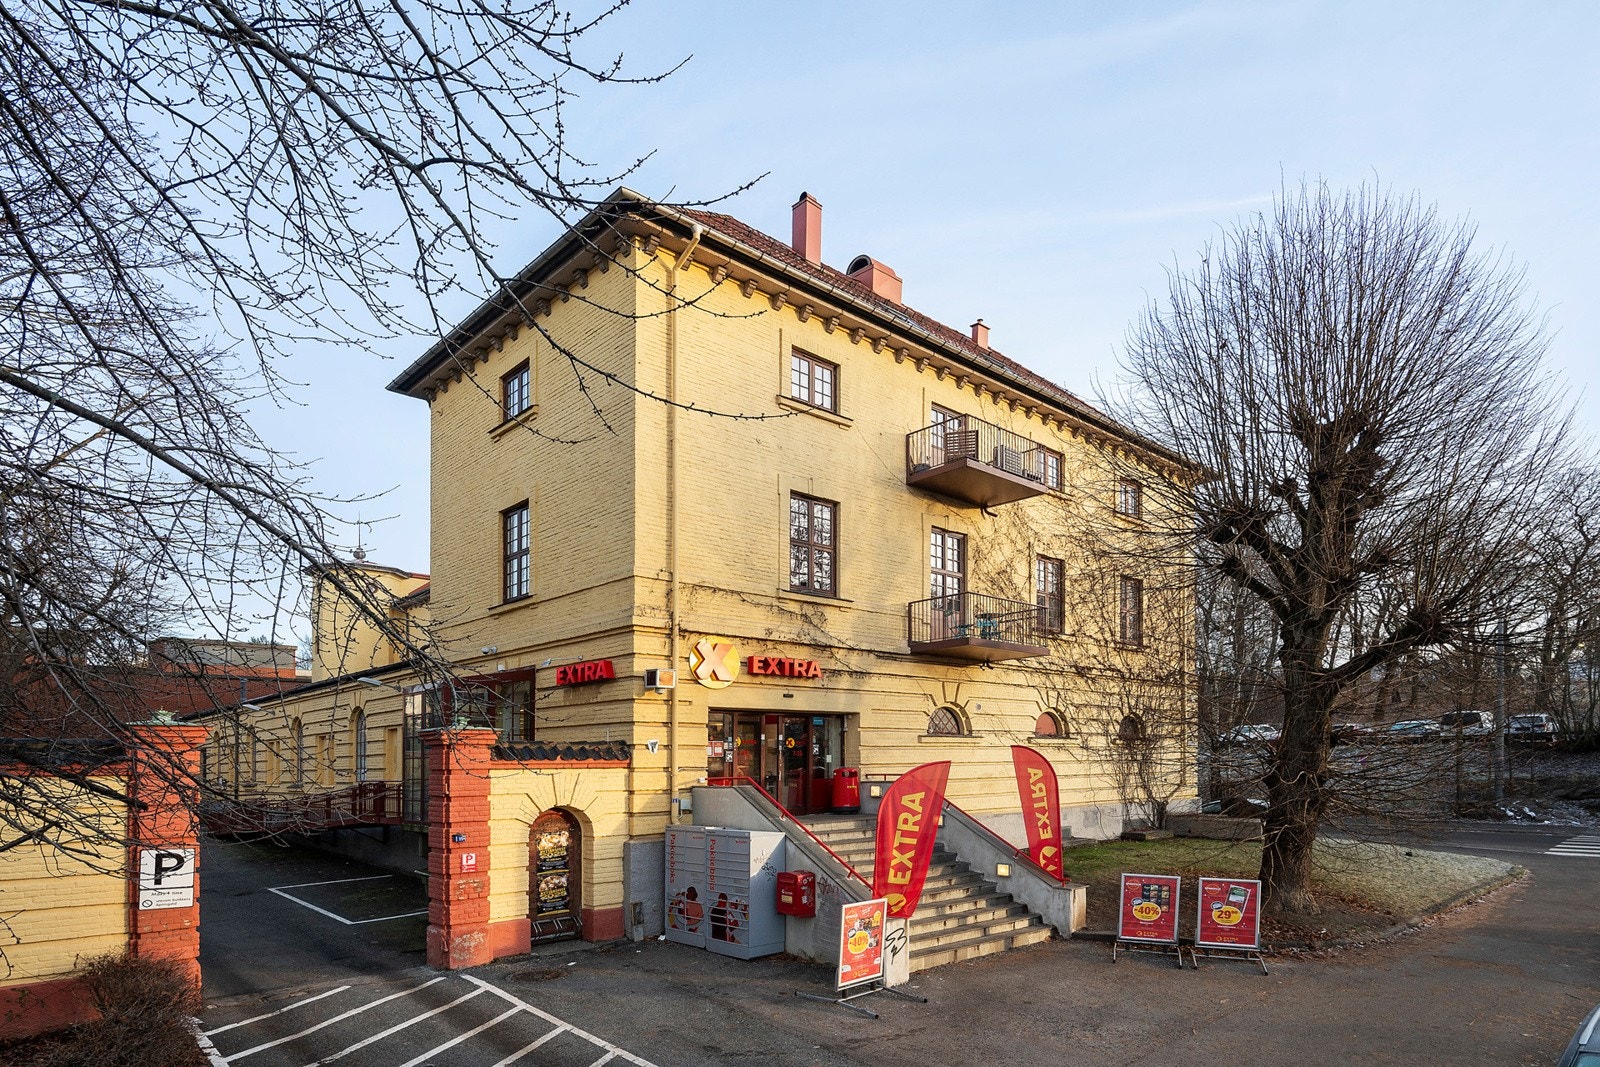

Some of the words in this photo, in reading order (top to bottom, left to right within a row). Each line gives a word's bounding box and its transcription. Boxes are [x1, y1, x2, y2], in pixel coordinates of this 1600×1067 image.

[557, 659, 607, 685] EXTRA
[752, 655, 823, 679] EXTRA
[888, 791, 925, 885] EXTRA
[465, 854, 474, 864] P
[154, 853, 185, 886] P
[1134, 906, 1160, 916] -40%
[1217, 910, 1232, 920] 29
[849, 935, 869, 948] -40%
